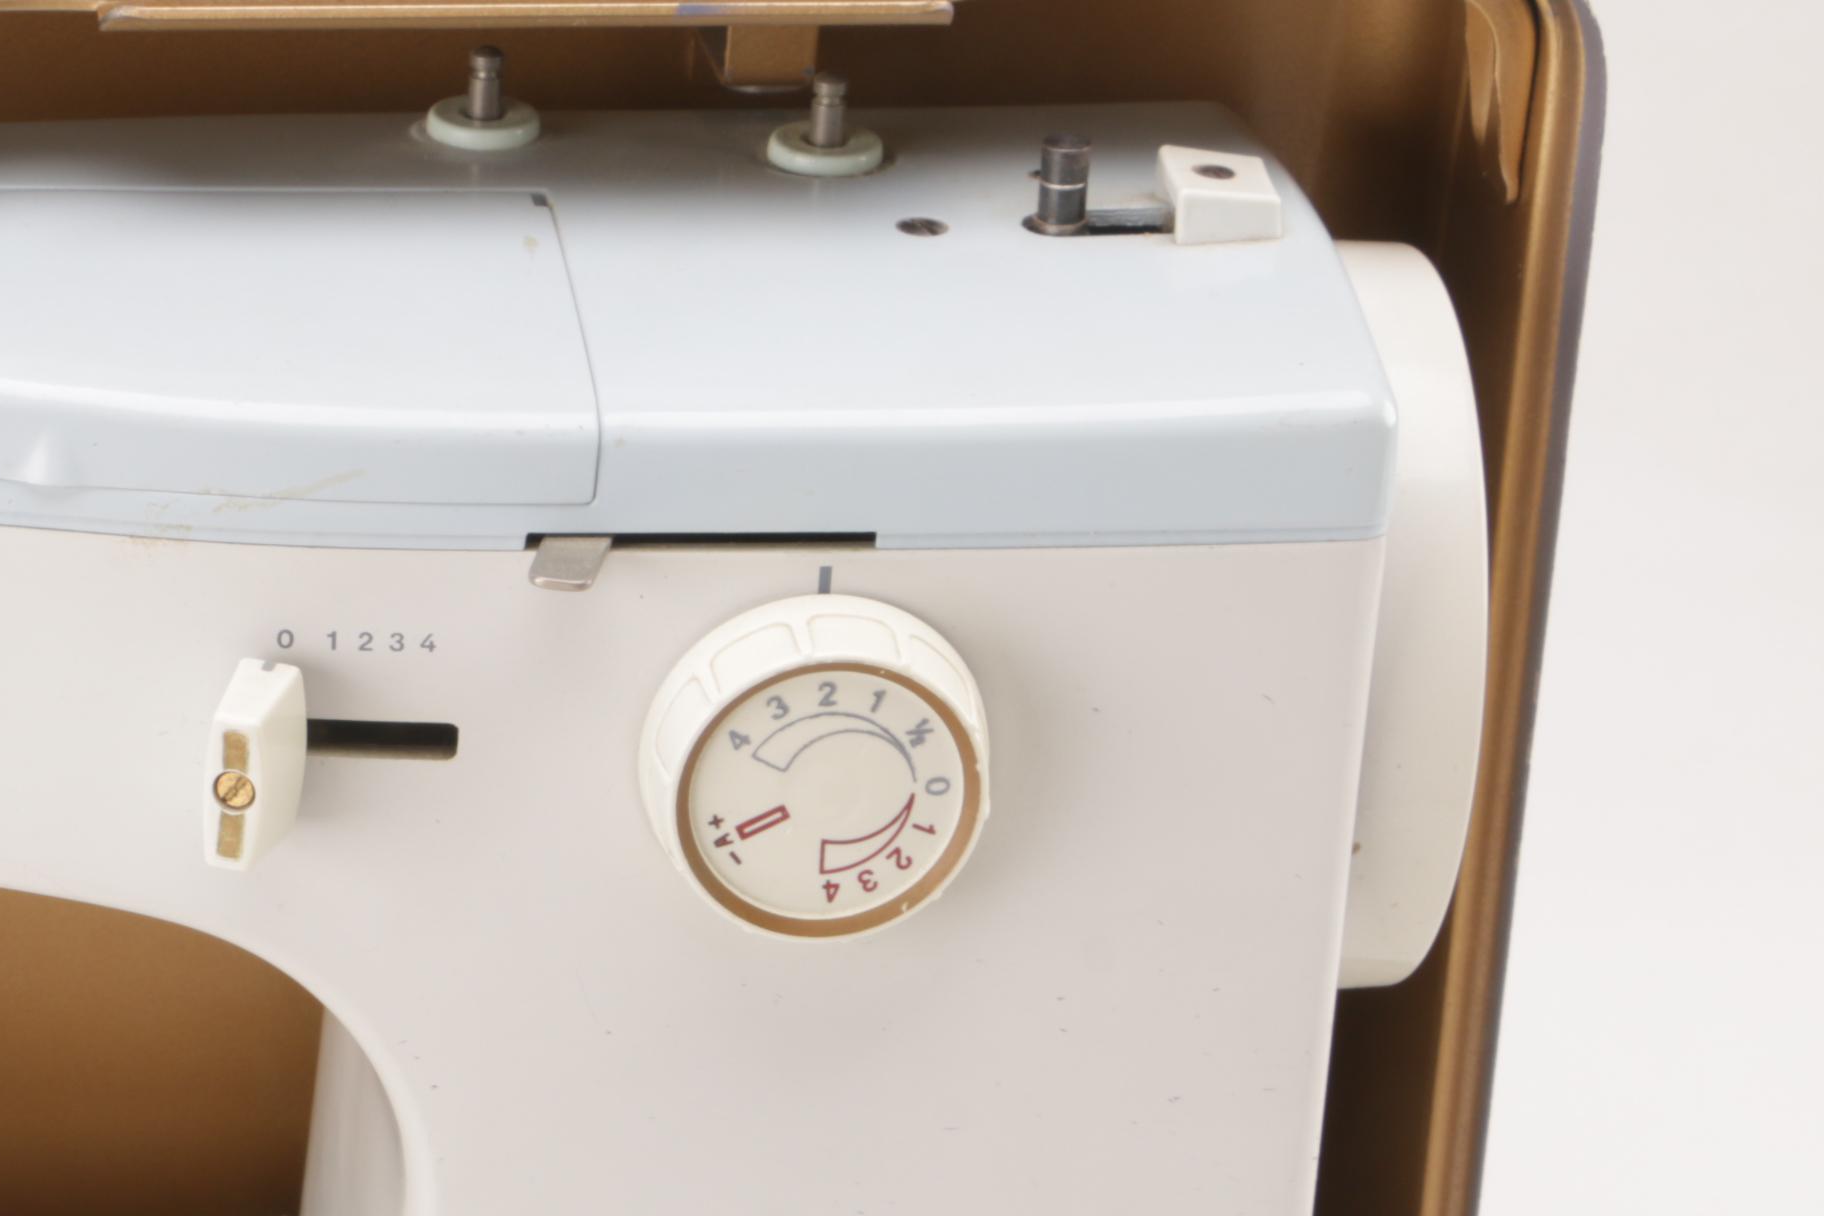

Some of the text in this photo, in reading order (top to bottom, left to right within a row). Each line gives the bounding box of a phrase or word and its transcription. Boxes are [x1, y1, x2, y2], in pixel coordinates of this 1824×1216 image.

[277, 630, 436, 652] 0 1 2 3 4
[728, 730, 750, 750] 4
[766, 695, 789, 720] 3
[819, 682, 837, 707] 2
[871, 690, 886, 712] 1
[925, 777, 950, 796] 0
[823, 824, 936, 903] 1 2 3 4
